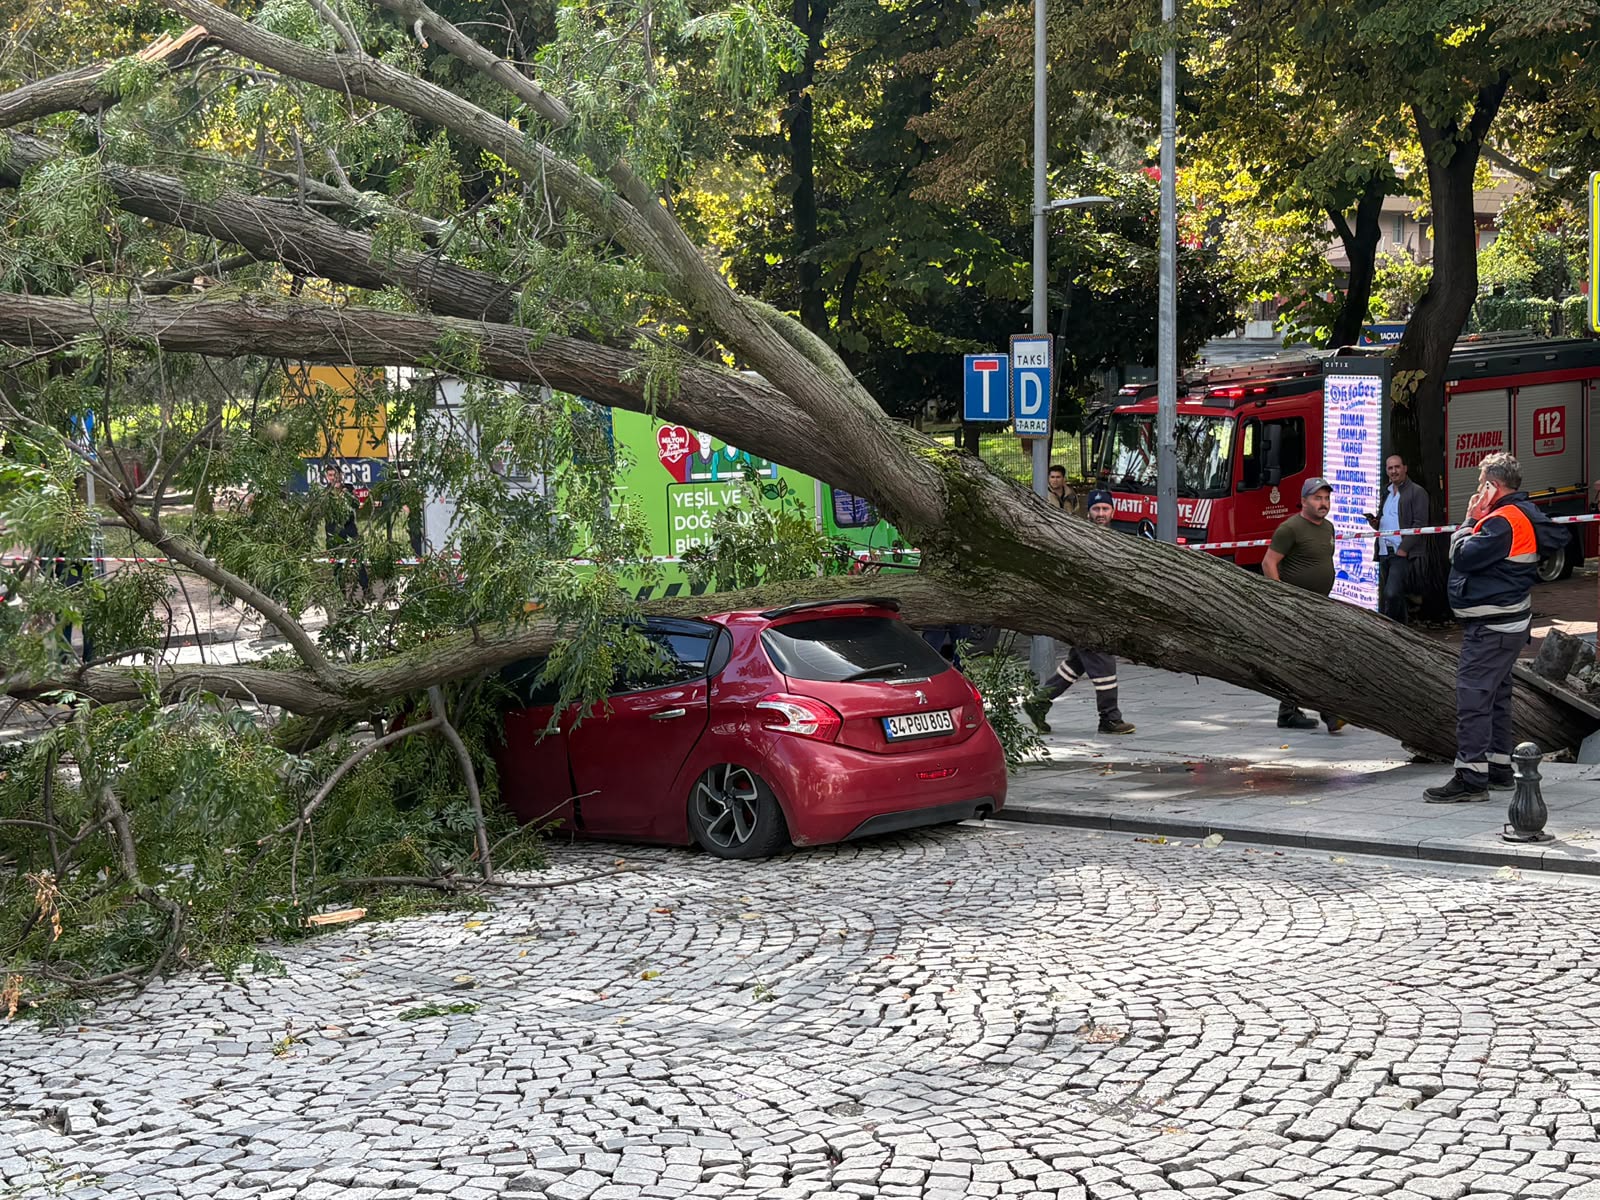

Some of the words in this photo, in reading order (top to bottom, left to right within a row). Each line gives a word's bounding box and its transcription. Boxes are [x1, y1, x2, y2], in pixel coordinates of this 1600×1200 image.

[1017, 352, 1046, 366] TAKSİ
[1021, 371, 1043, 415] D
[1340, 413, 1365, 426] DUMAN
[1538, 411, 1561, 435] 112
[1337, 428, 1367, 441] ADAMLAR
[1341, 442, 1363, 454] KARGO
[673, 487, 719, 509] YEŞİL
[720, 489, 742, 506] VE
[674, 510, 717, 531] DOĞ
[890, 718, 906, 735] 34
[906, 715, 929, 733] PGU
[929, 713, 951, 730] 805
